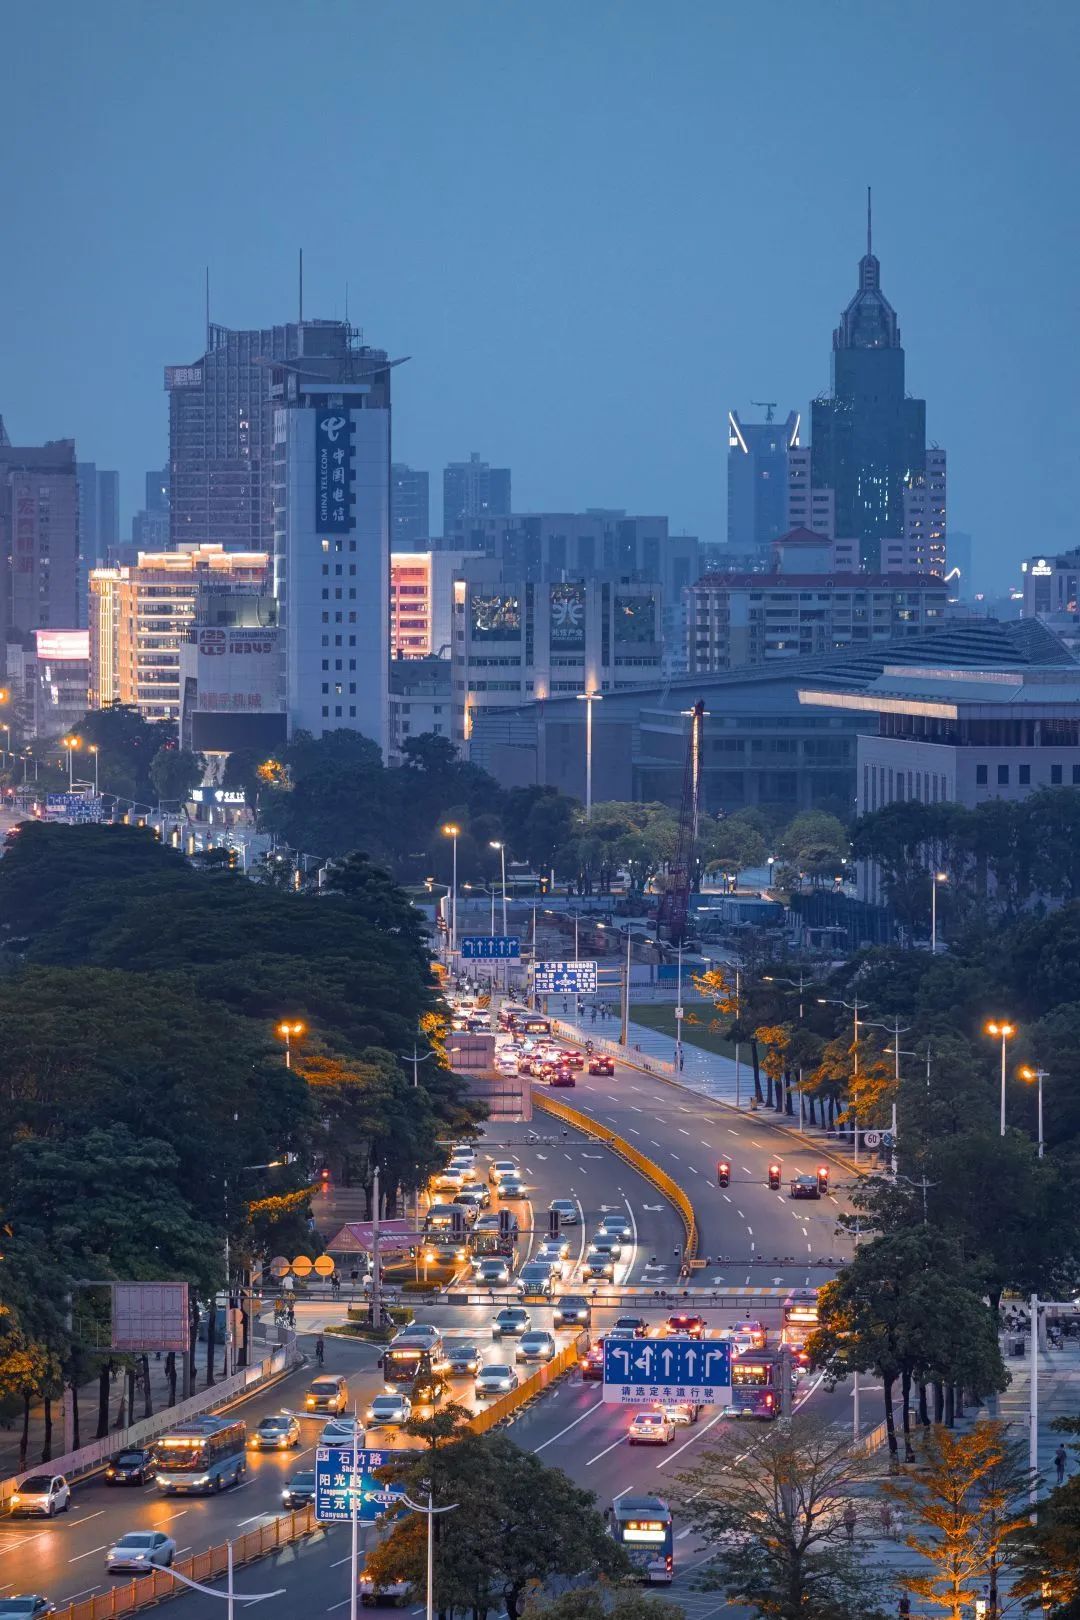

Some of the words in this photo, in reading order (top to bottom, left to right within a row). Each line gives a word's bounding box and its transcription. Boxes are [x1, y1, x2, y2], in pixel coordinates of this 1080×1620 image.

[320, 449, 328, 490] TELECOM
[333, 448, 345, 521] 中国电信
[320, 492, 328, 521] CHINA
[868, 1134, 877, 1144] 60
[621, 1386, 714, 1398] 请选定车道行驶
[338, 1452, 382, 1465] 石竹路
[320, 1474, 363, 1487] 阳光路
[320, 1497, 362, 1511] 三元路
[320, 1510, 349, 1519] Sanyuan
